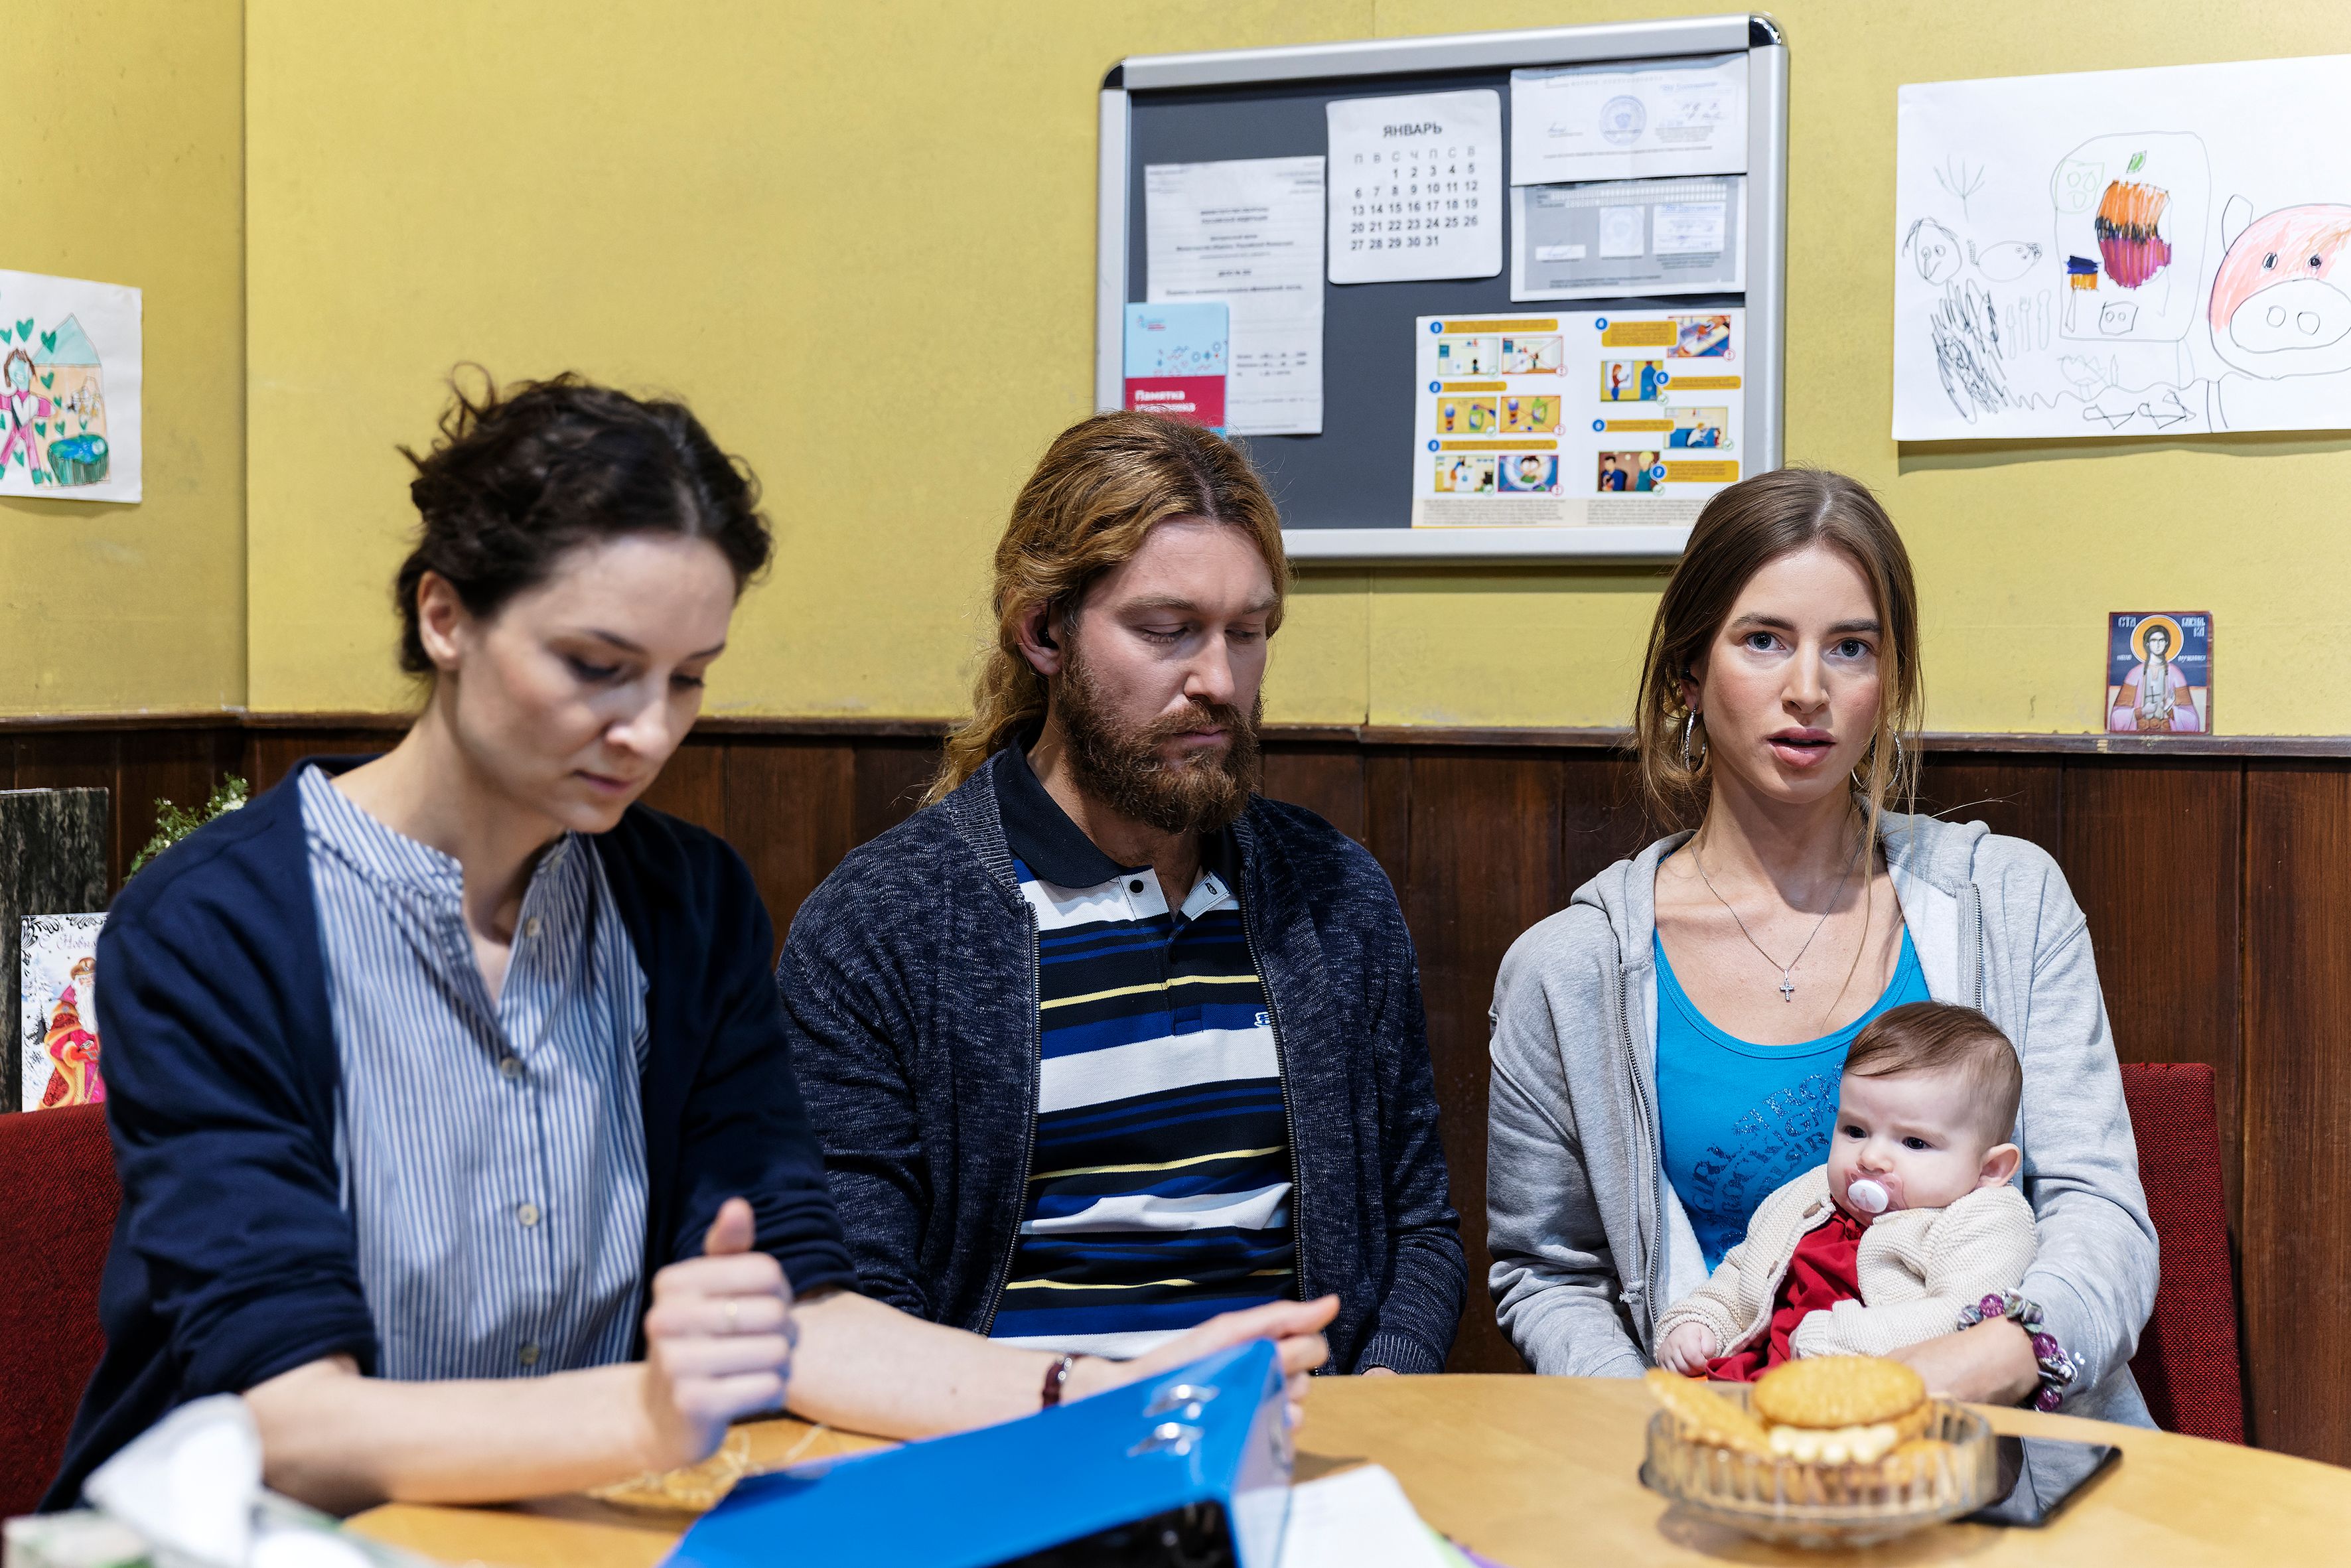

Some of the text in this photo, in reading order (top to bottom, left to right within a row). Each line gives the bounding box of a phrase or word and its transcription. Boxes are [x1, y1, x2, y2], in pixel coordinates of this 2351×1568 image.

[1384, 122, 1443, 137] ЯНВАРЬ
[1427, 182, 1441, 194] 10
[1447, 182, 1458, 192] 11
[1465, 180, 1478, 192] 12
[1352, 198, 1478, 216] 13 14 15 16 17 18 19
[1352, 215, 1478, 234] 20 21 22 23 24 25 26
[1352, 236, 1439, 251] 27 28 29 30 31
